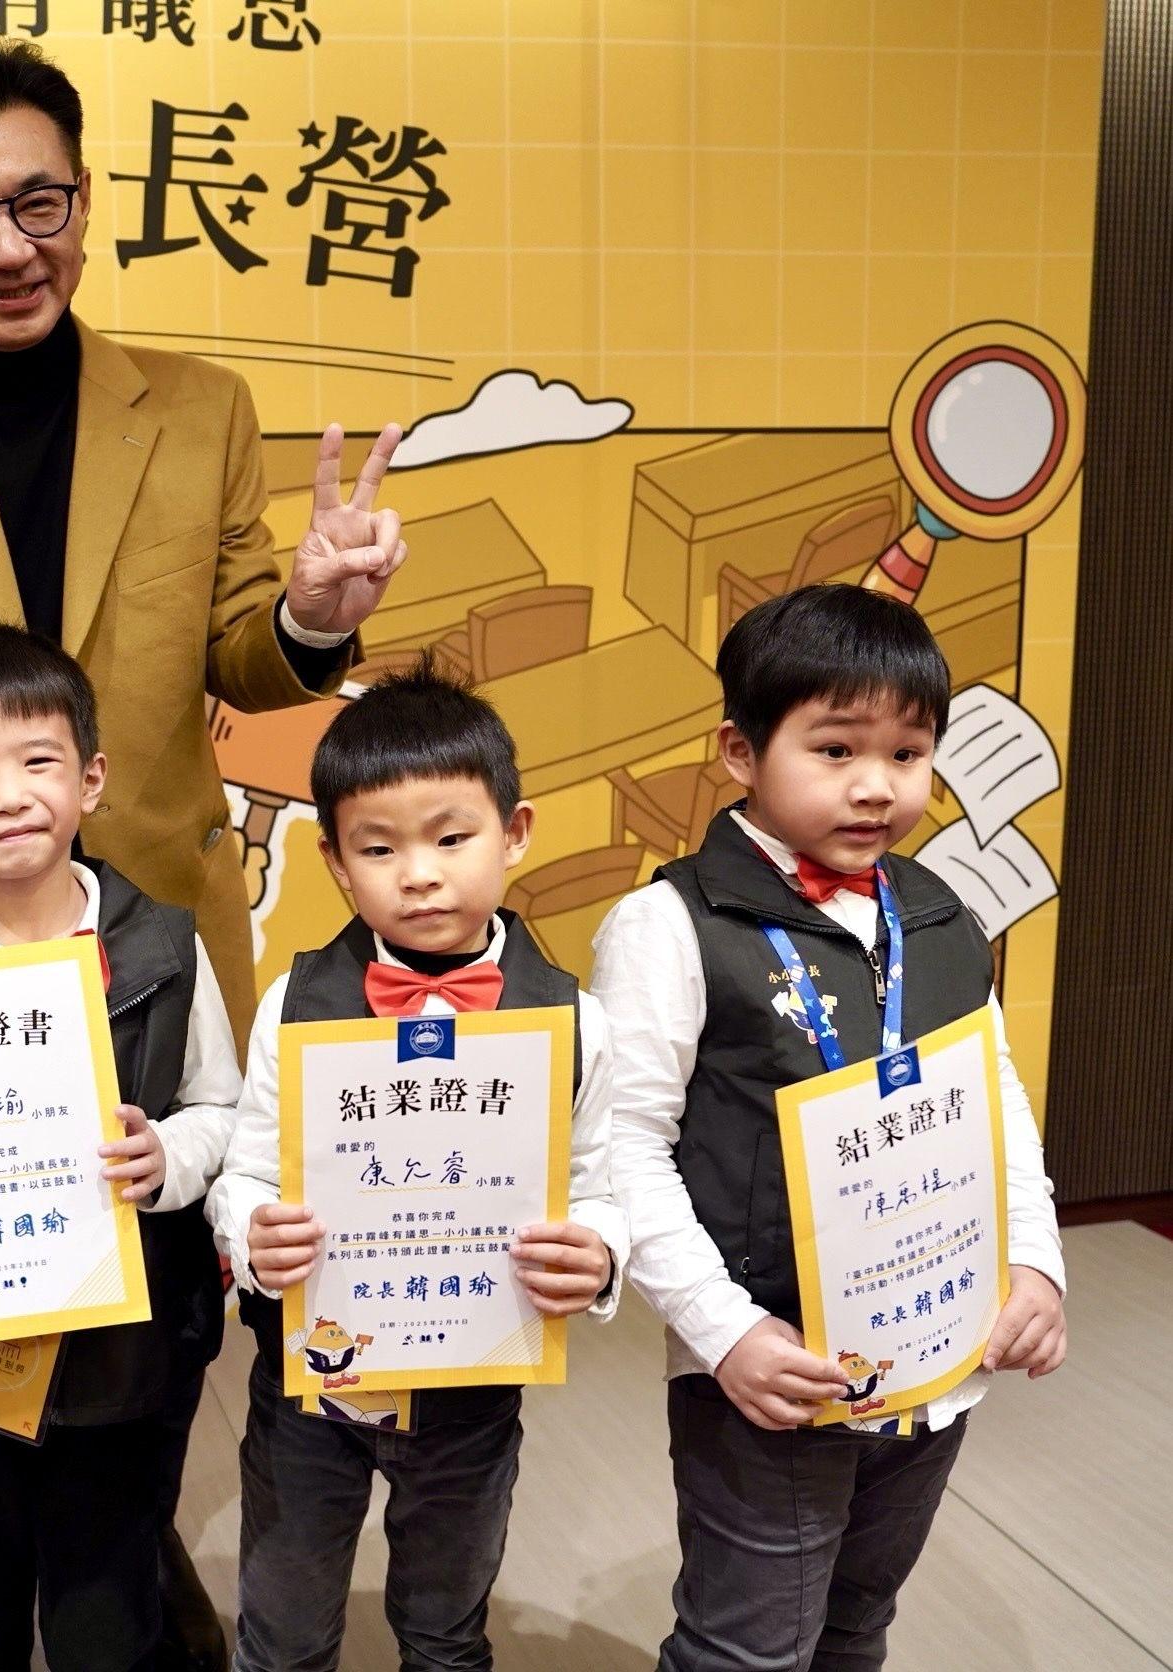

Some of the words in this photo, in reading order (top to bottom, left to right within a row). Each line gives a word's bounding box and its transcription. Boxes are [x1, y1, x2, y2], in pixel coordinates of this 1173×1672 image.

[338, 1078, 514, 1122] 結業證書
[32, 1105, 69, 1119] 小朋友
[836, 1088, 964, 1166] 結業證書
[336, 1141, 375, 1153] 親愛的
[477, 1176, 515, 1186] 小朋友
[839, 1179, 873, 1197] 親愛的
[951, 1172, 976, 1191] 小朋友
[392, 1211, 456, 1222] 恭喜你完成
[895, 1221, 942, 1249] 恭喜你完成
